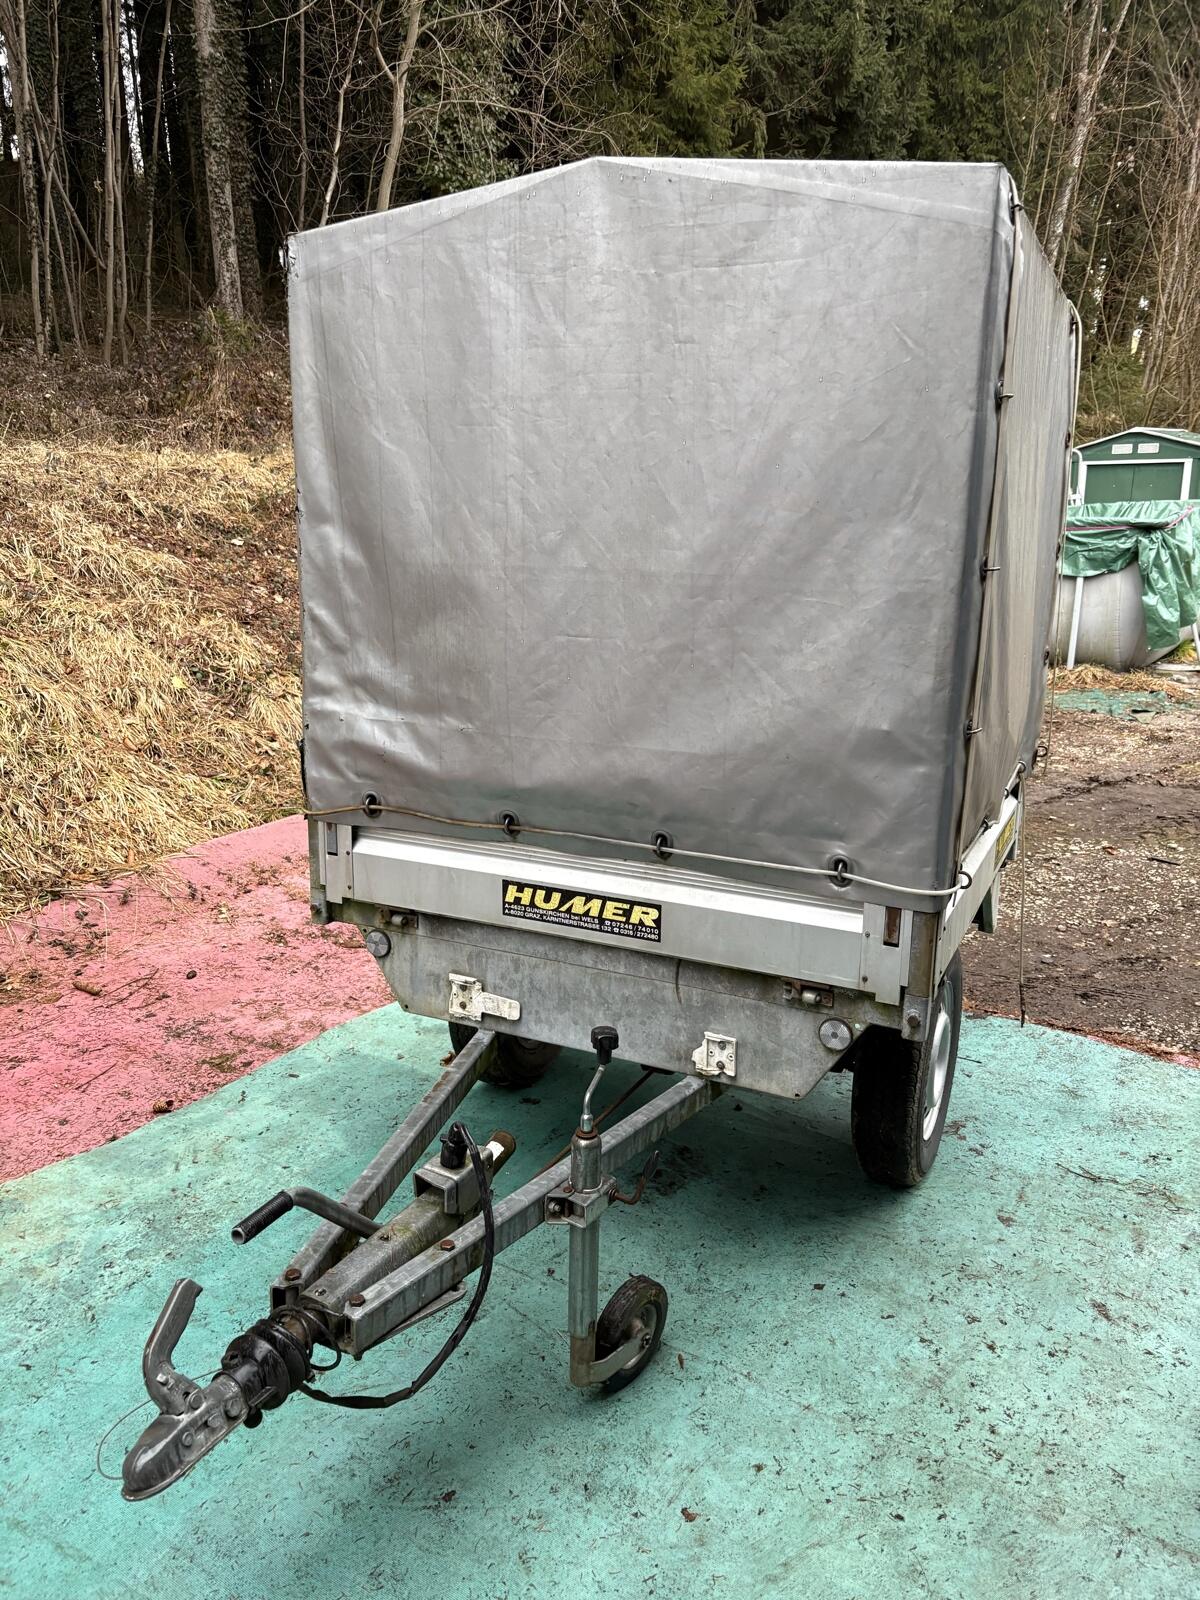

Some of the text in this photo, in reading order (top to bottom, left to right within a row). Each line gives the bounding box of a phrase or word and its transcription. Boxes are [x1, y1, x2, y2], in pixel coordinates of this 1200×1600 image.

[505, 884, 659, 928] HUMER
[525, 906, 570, 919] GUNSKIRCHEN
[582, 916, 598, 924] WELS
